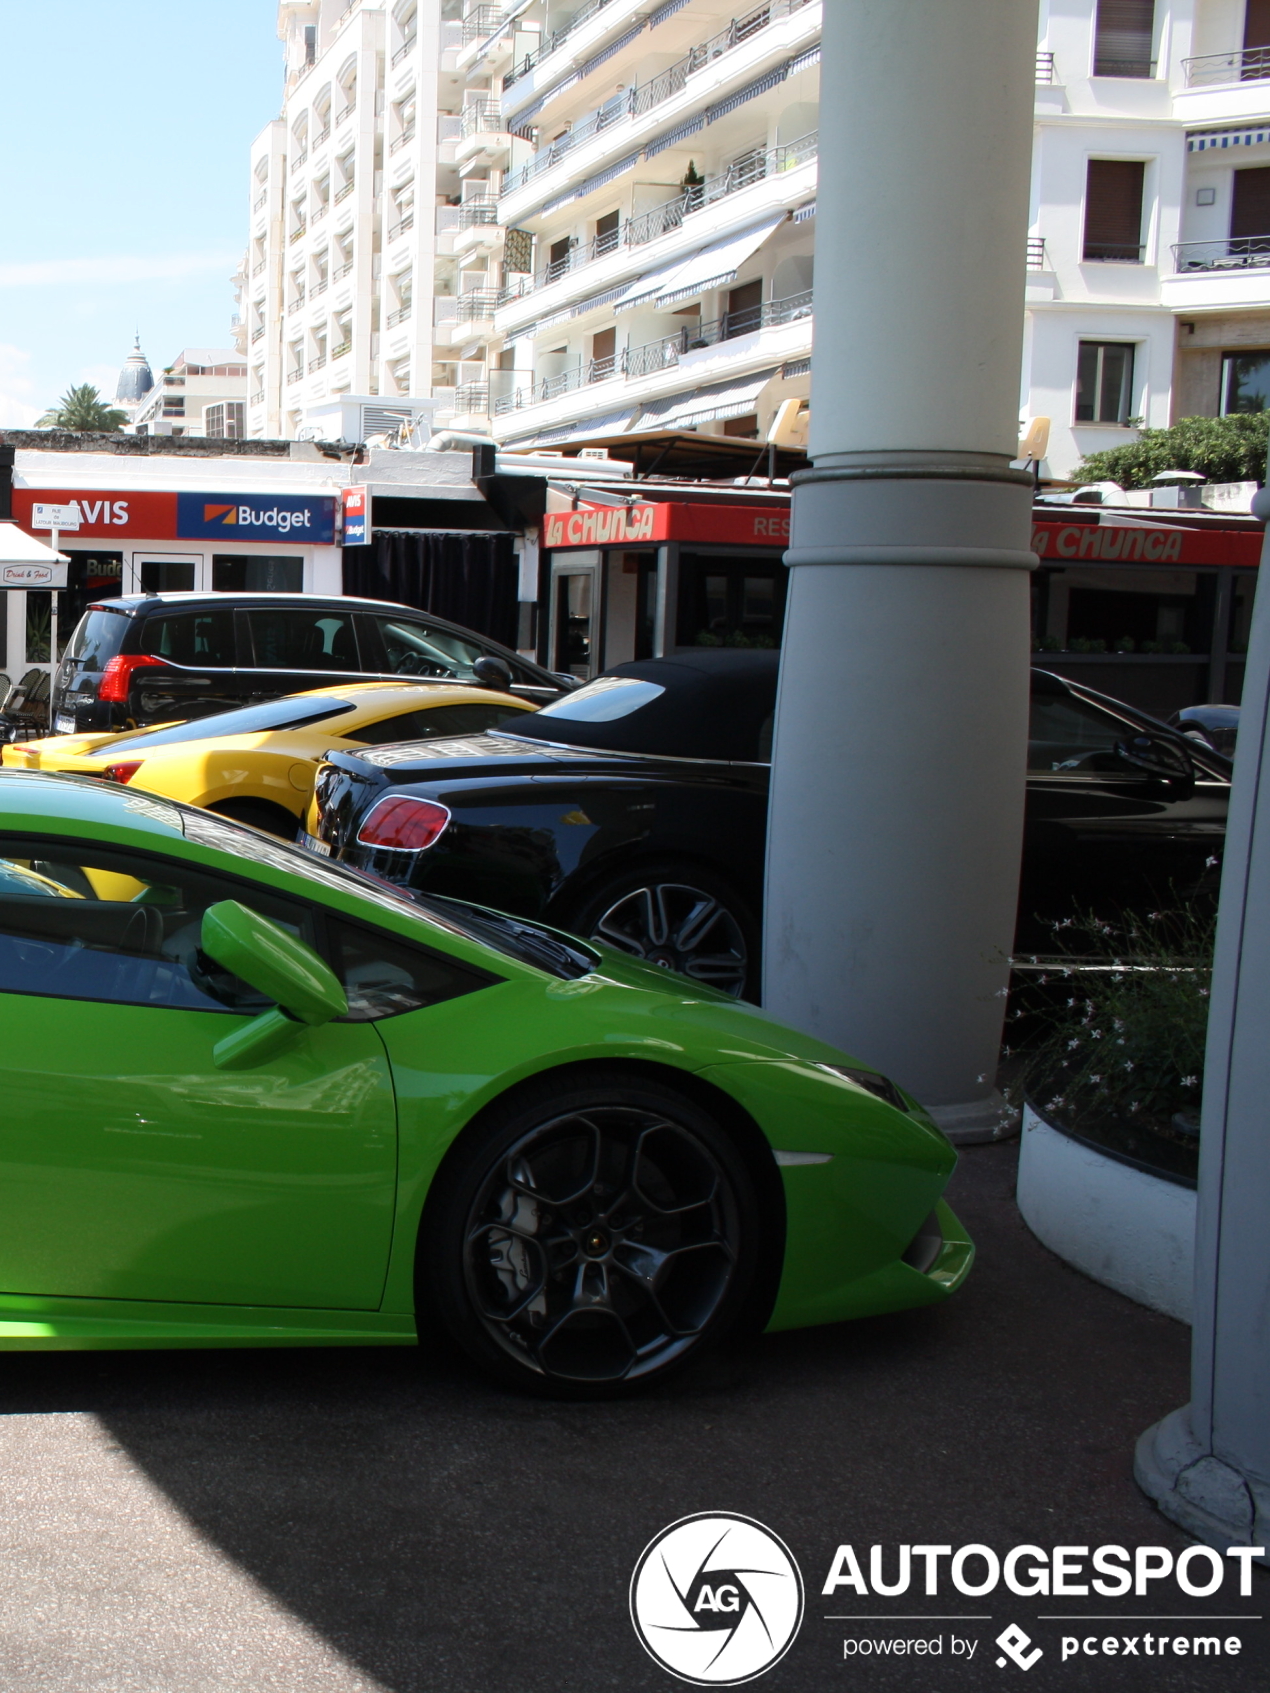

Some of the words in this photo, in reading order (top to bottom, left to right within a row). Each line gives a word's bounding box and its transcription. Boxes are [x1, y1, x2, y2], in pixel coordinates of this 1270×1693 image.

[346, 494, 362, 508] AVIS
[238, 506, 311, 532] Budget
[6, 570, 25, 578] Drink
[33, 570, 49, 579] Food
